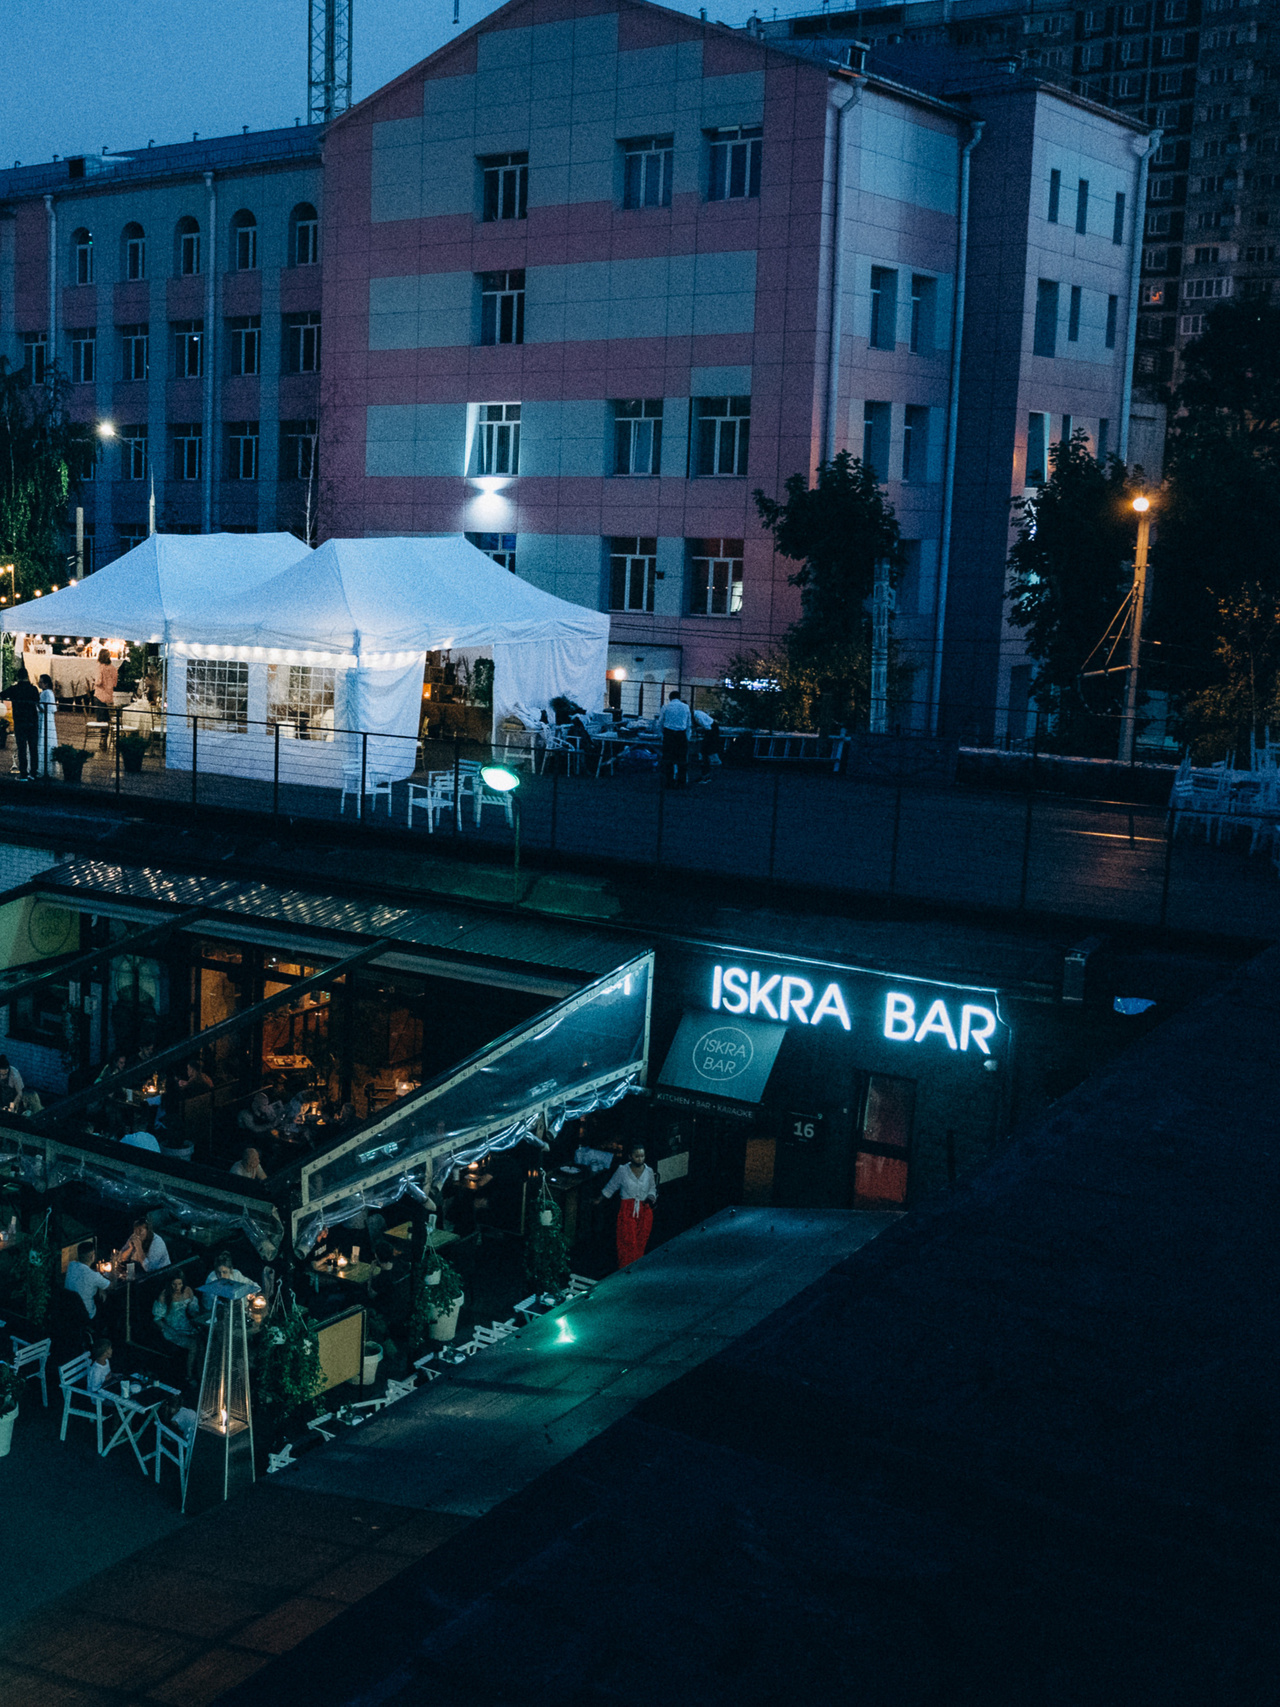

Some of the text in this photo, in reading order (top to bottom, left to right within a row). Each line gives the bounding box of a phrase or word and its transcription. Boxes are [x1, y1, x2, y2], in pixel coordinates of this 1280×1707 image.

[710, 964, 996, 1055] ISKRA BAR
[703, 1038, 746, 1058] ISKRA
[702, 1056, 736, 1074] BAR
[656, 1093, 754, 1119] KITCHEN BAR KARAOKE
[793, 1121, 815, 1139] 16
